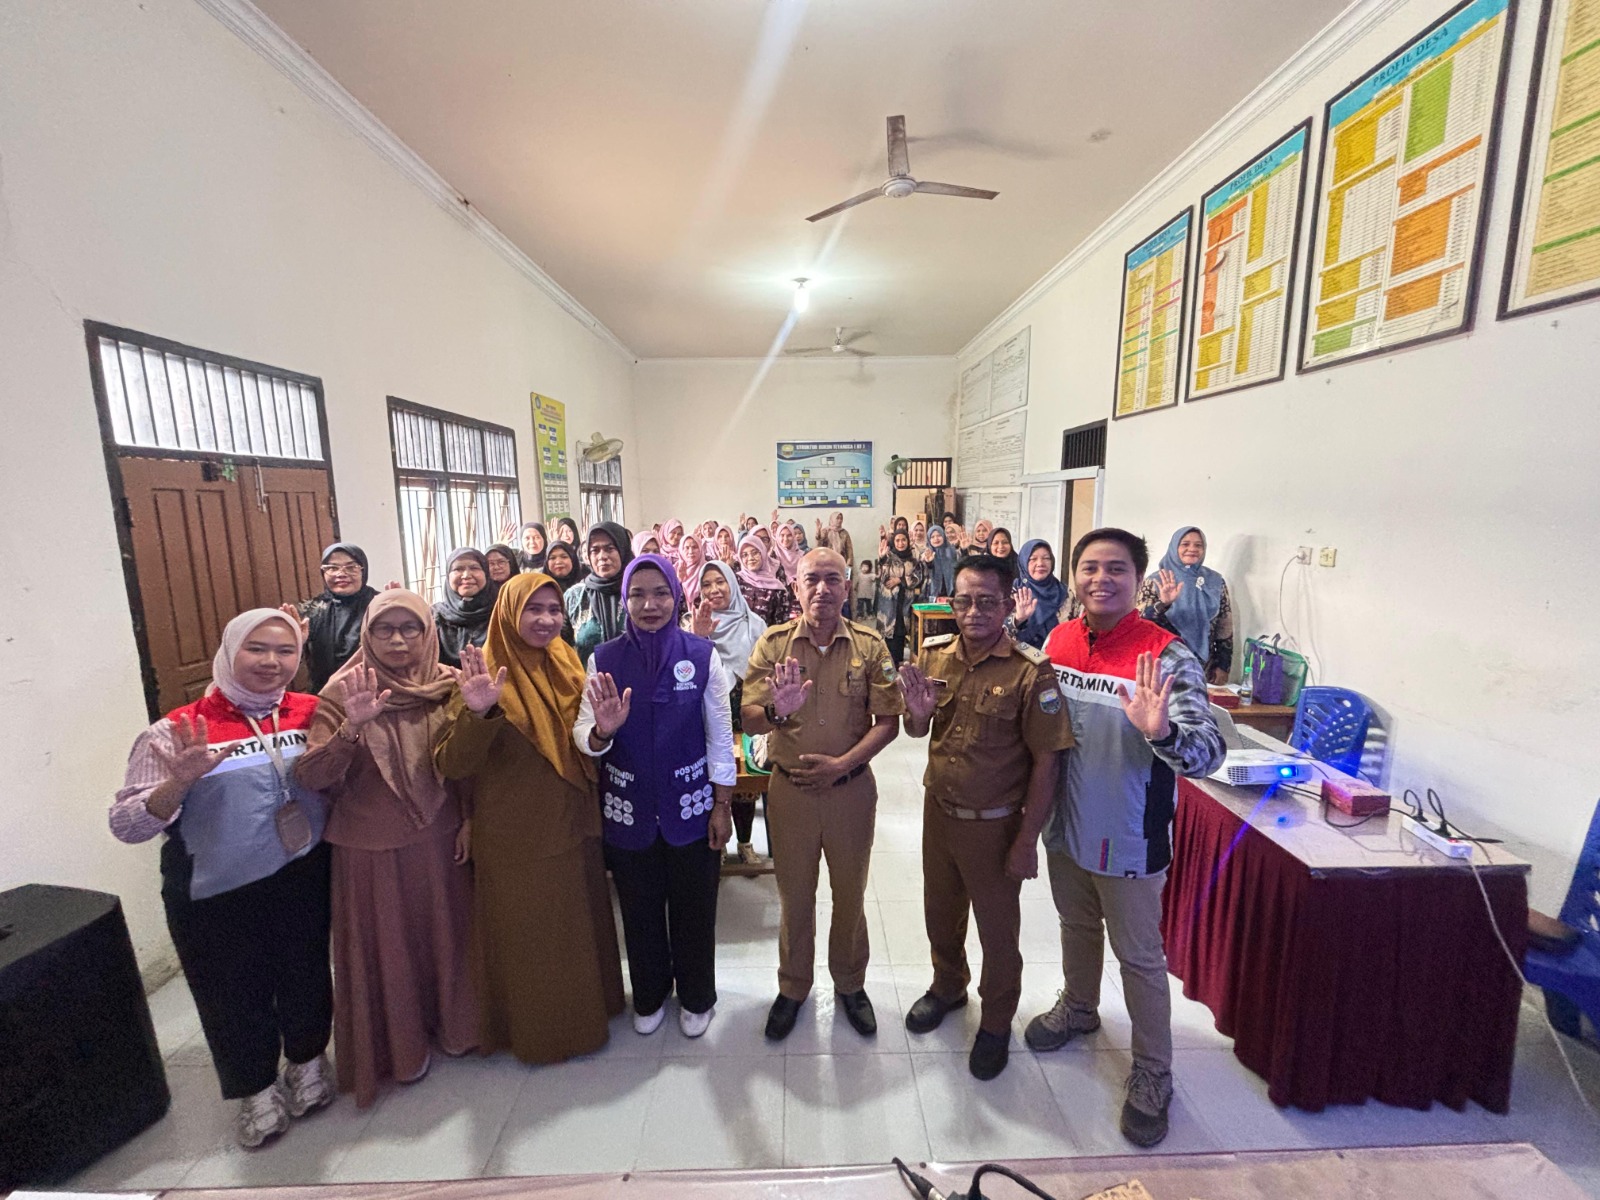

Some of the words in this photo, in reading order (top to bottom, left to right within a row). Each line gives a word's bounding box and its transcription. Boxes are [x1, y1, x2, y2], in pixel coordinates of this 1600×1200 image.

[1372, 52, 1413, 87] PROFIL
[1416, 27, 1448, 56] DESA
[685, 774, 690, 782] 6
[691, 767, 704, 781] SPM
